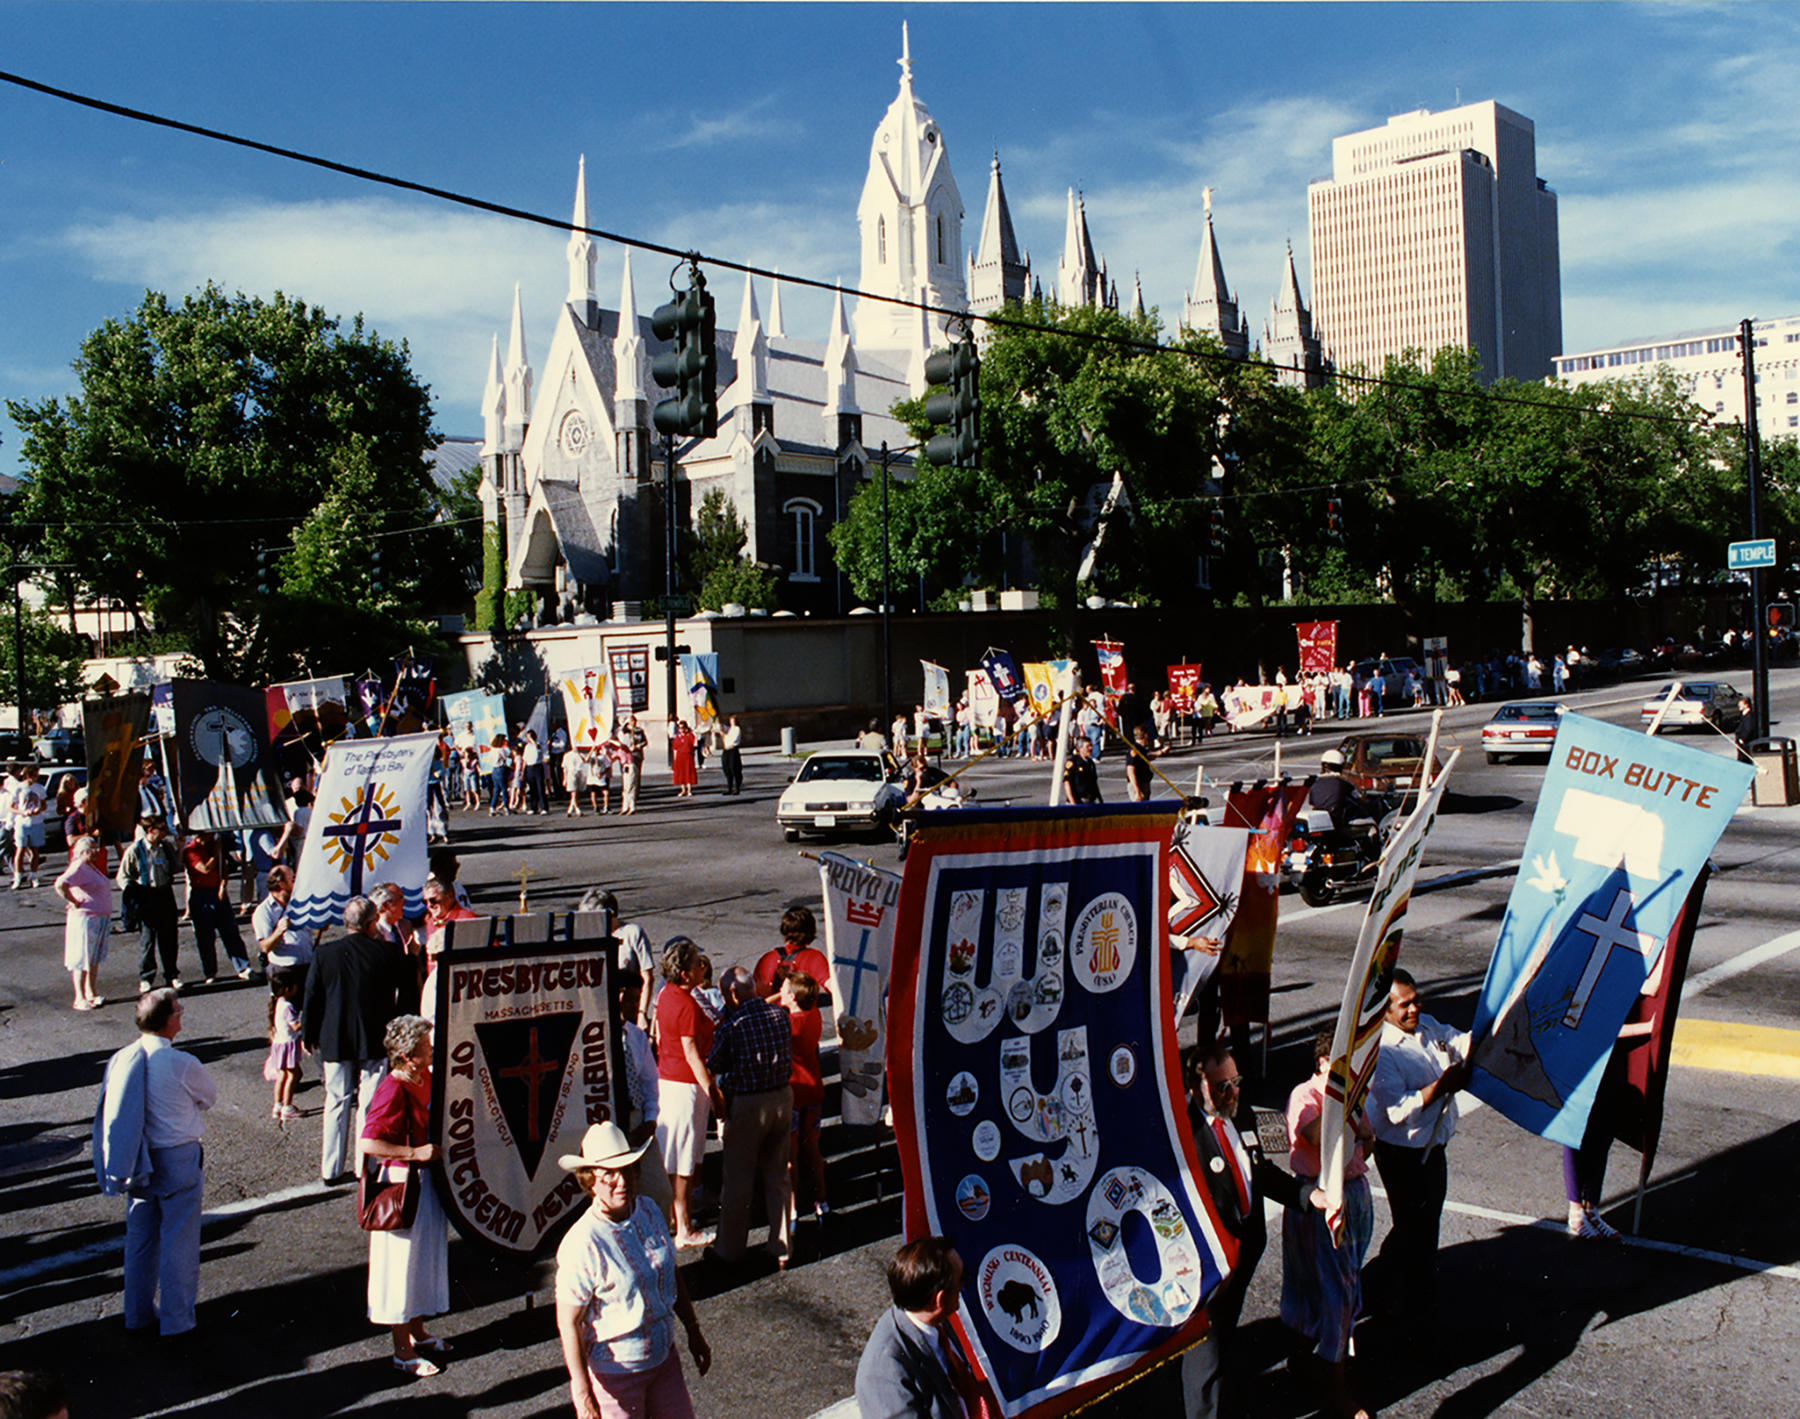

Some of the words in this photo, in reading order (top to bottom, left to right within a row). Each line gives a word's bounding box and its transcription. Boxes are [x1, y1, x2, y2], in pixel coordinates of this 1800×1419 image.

[1740, 546, 1774, 561] TEMPLE
[343, 764, 356, 776] of
[356, 764, 386, 776] Tampa
[387, 761, 407, 772] Bay
[344, 751, 363, 762] The
[365, 748, 415, 760] Presbytery
[1565, 745, 1619, 779] BOX
[1624, 762, 1719, 809] BUTTE
[1075, 899, 1119, 956] PRESBYTERIAN
[1120, 904, 1135, 945] CHURCH
[451, 957, 605, 1004] PRESBYTERY
[451, 1041, 475, 1081] OF
[582, 1021, 611, 1126] GLAND
[478, 1067, 515, 1147] CONNECTICUT
[549, 1102, 567, 1143] RHODE
[561, 1053, 579, 1098] ISLAND
[448, 1098, 527, 1244] SOUTHERN
[532, 1172, 583, 1234] NEW
[983, 1256, 1000, 1311] WYOMING
[1003, 1250, 1051, 1296] CENTENNIAL
[1010, 1326, 1032, 1345] 1890
[1032, 1319, 1051, 1343] 1990
